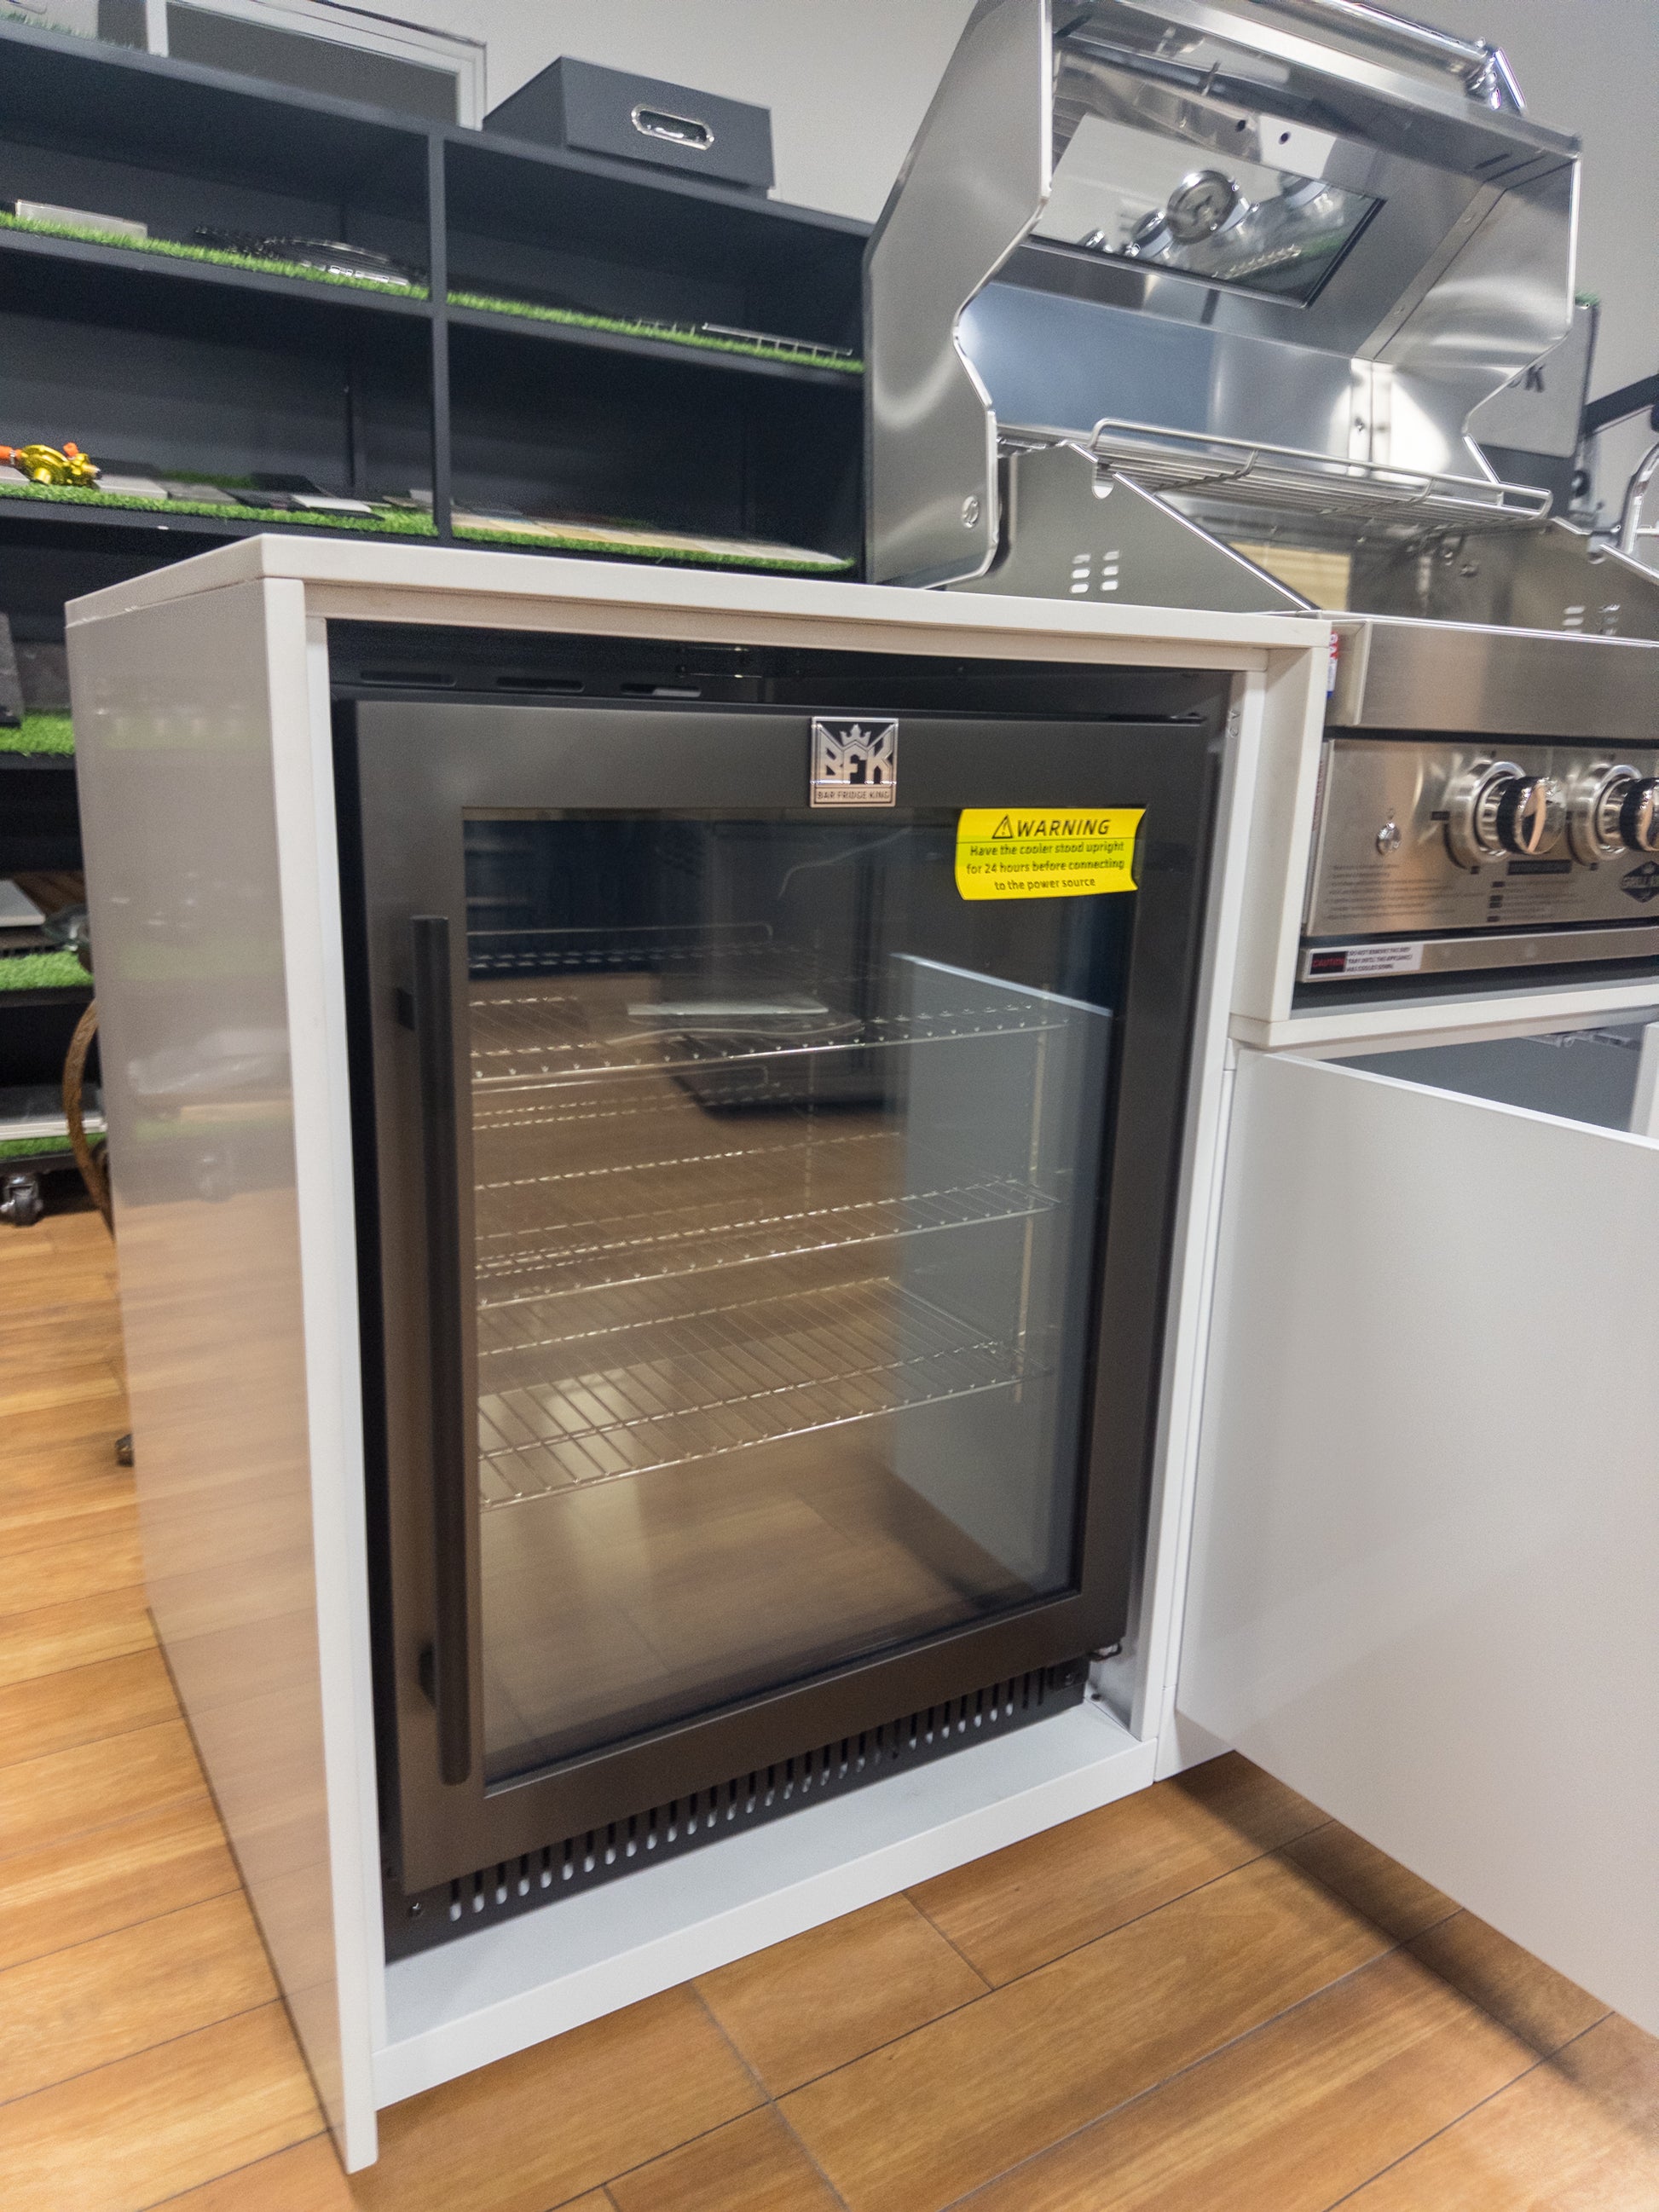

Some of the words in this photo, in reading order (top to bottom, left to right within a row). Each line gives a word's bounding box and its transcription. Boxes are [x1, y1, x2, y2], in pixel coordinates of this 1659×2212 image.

[818, 790, 835, 800] BAR
[837, 790, 866, 800] FRIDGE
[869, 790, 890, 800] KING
[1016, 819, 1111, 837] WARNING
[969, 845, 997, 857] Have
[1000, 843, 1017, 855] the
[1020, 842, 1052, 855] cooler
[1055, 841, 1084, 853] stood
[1086, 840, 1125, 854] upright
[966, 863, 981, 875] for
[985, 863, 997, 874] 24
[999, 861, 1030, 873] hours
[1032, 859, 1066, 872] before
[1068, 858, 1125, 871] connecting
[994, 881, 1006, 891] to
[1007, 879, 1025, 890] the
[1027, 880, 1060, 892] power
[1061, 877, 1095, 888] source
